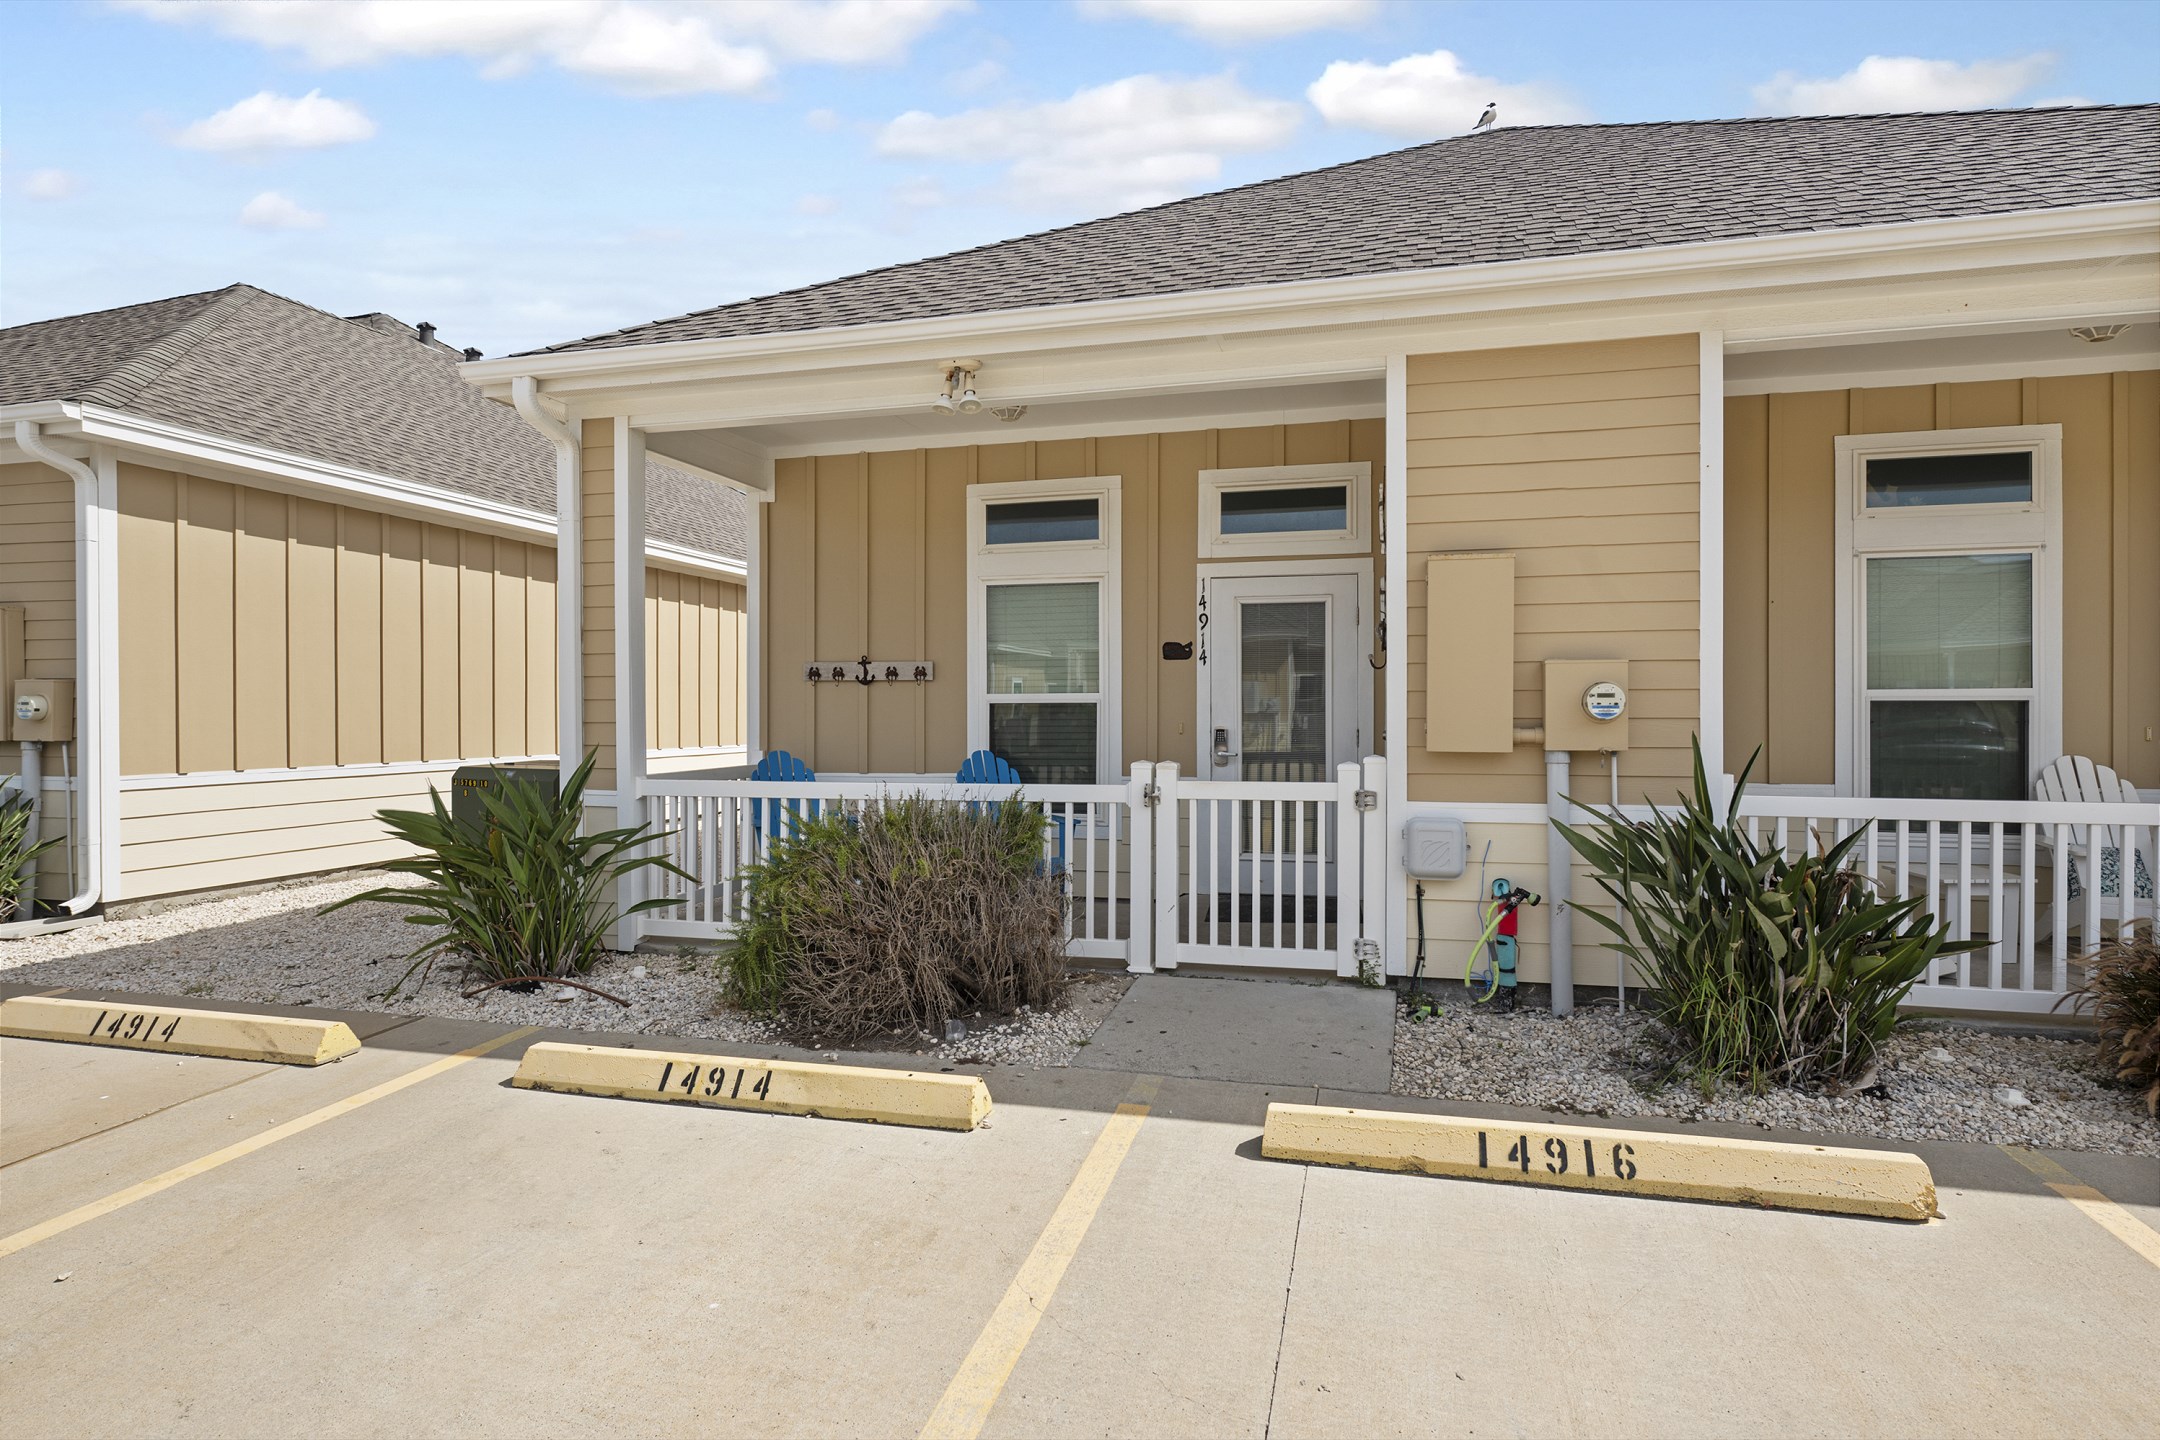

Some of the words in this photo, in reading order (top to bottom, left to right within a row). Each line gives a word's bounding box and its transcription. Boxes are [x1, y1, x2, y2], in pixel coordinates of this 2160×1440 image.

[1198, 578, 1209, 666] 14914
[89, 1010, 182, 1043] 14914
[657, 1061, 773, 1101] 14914
[1478, 1131, 1637, 1181] 14916
